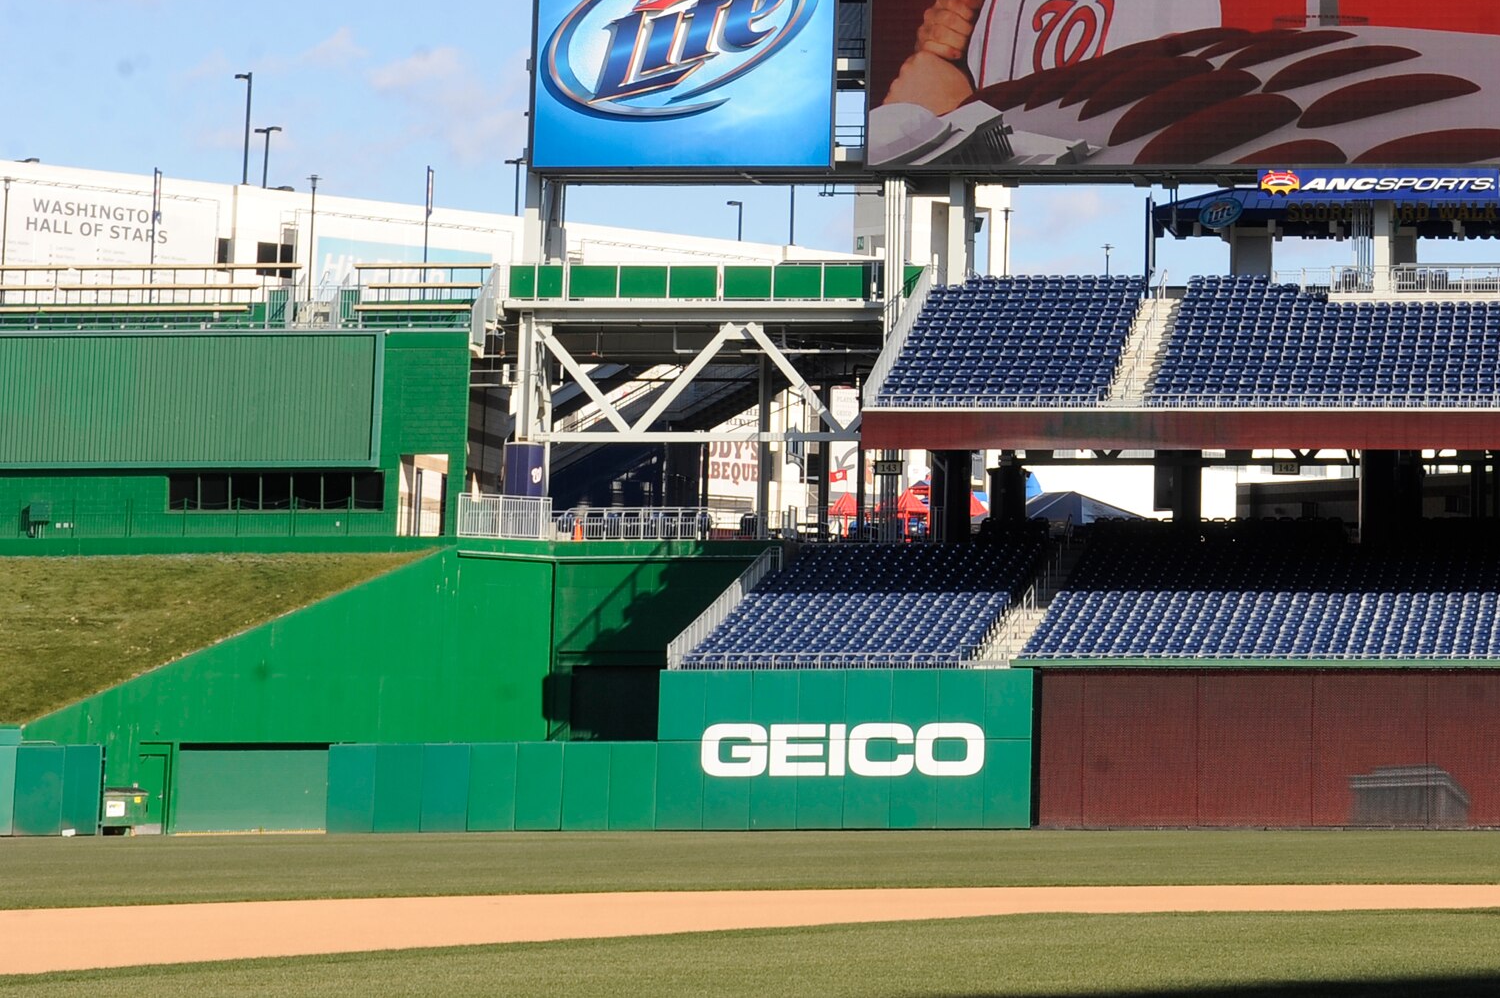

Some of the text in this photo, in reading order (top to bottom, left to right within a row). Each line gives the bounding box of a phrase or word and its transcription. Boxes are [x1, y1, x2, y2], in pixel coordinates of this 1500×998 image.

[1437, 201, 1498, 220] WALK
[25, 215, 169, 245] HALL OF STARS
[881, 464, 897, 472] 143
[1279, 463, 1295, 472] 142
[701, 722, 986, 778] GEICO
